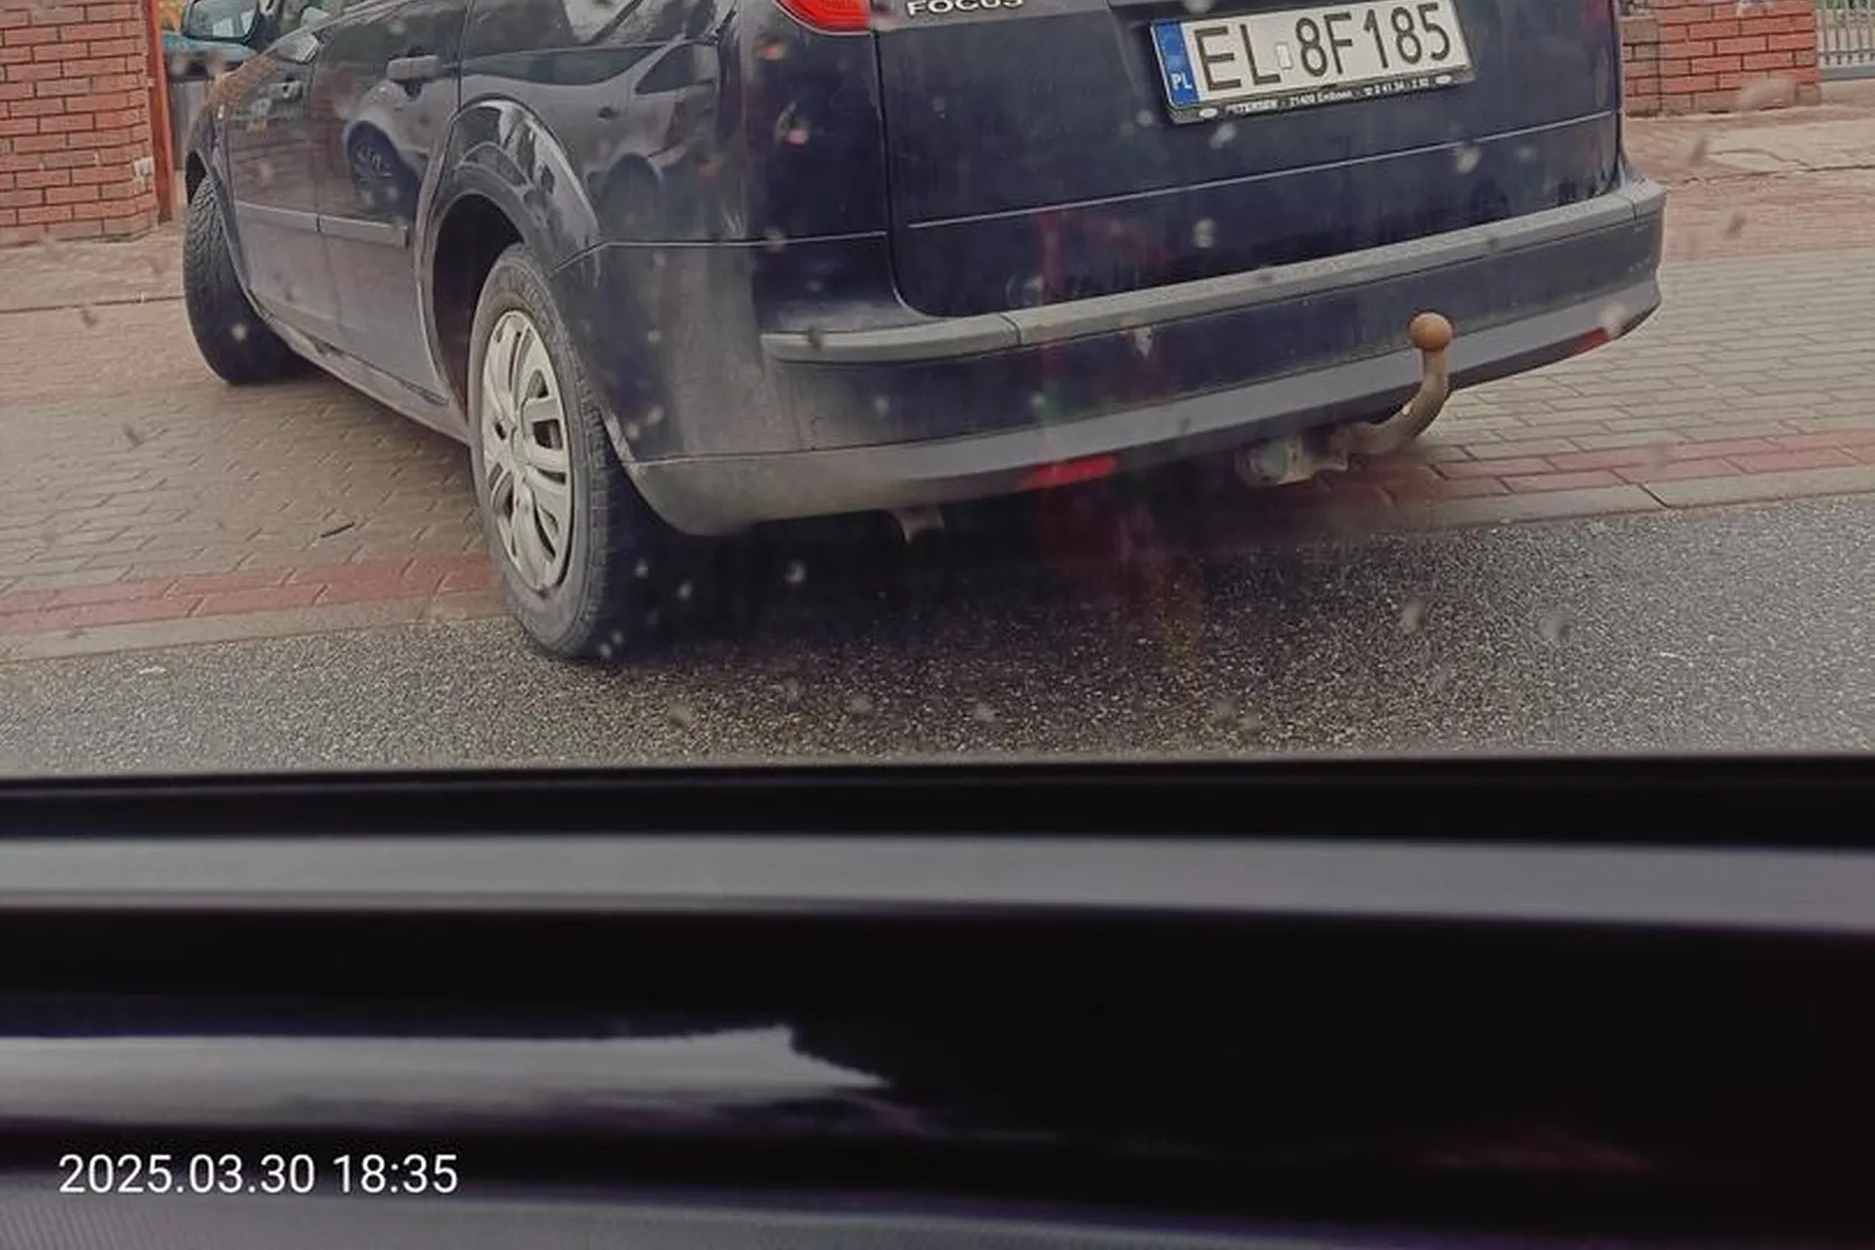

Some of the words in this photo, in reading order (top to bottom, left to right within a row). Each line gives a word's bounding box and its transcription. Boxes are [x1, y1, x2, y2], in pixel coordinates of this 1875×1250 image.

[1193, 23, 1282, 92] EL
[1295, 1, 1451, 78] 8F185
[1171, 73, 1193, 91] PL
